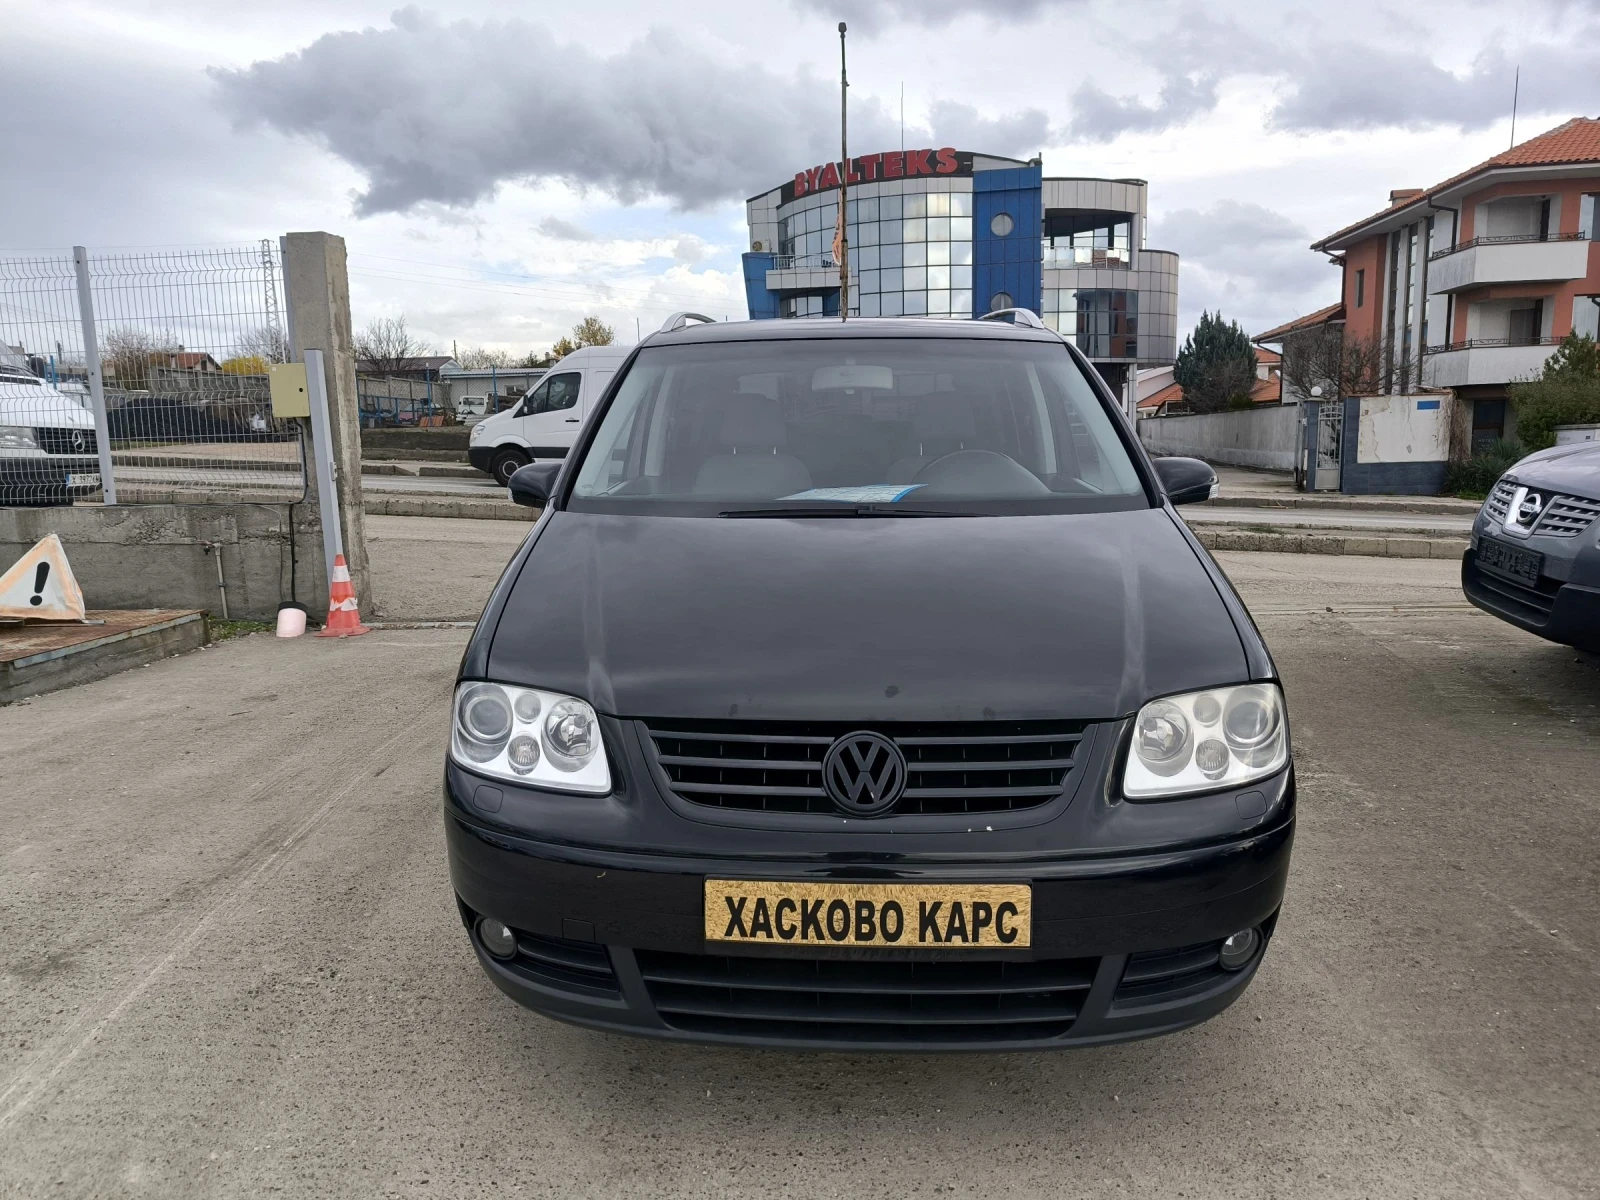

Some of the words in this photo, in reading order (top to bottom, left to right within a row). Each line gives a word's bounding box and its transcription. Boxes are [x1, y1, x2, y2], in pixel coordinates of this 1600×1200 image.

[794, 147, 959, 197] BYALTEKS
[724, 896, 904, 943] ХАСКОВО
[918, 901, 1019, 944] КАРС
